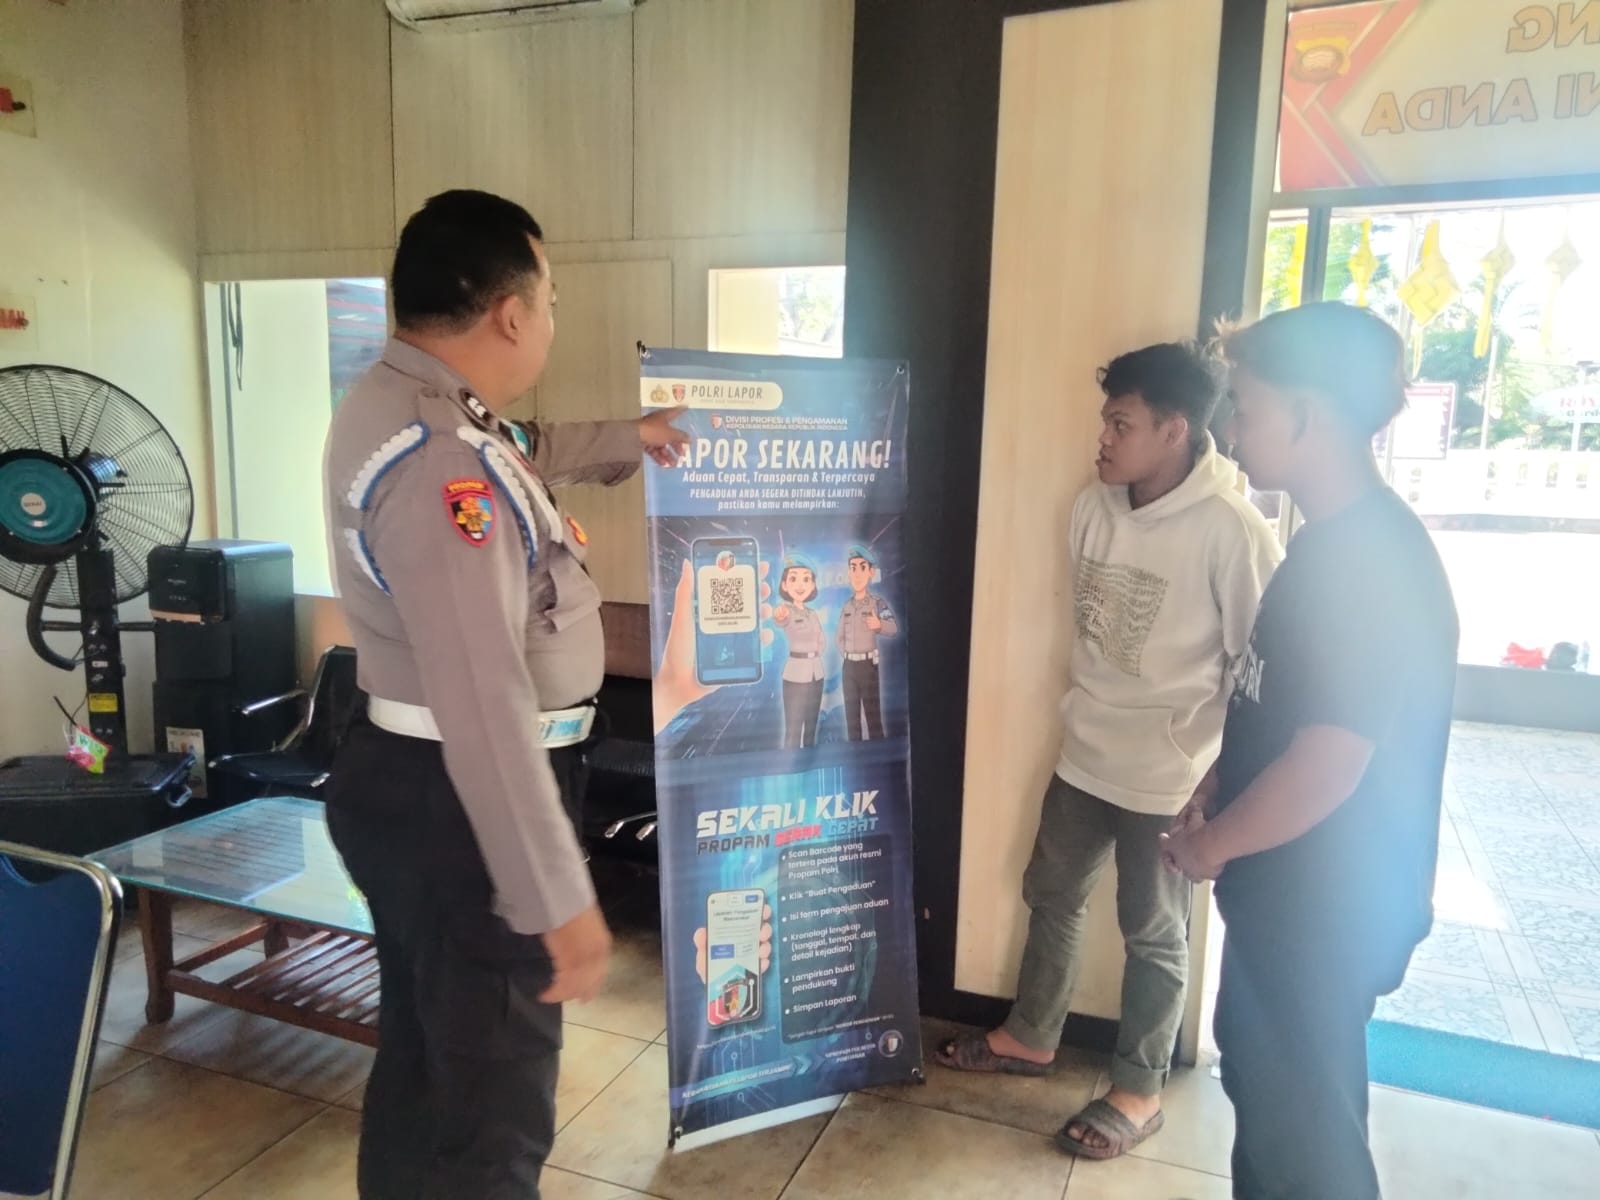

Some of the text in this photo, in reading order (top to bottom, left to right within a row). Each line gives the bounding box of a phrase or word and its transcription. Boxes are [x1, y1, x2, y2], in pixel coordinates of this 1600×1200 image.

[691, 385, 763, 400] POLRI LAPOR
[725, 415, 749, 425] DIVISI
[750, 415, 784, 425] PROFESI
[664, 438, 892, 469] APOR SEKARANG!
[682, 471, 876, 486] Aduan Cepat, Transparan & Terpercaya
[690, 488, 737, 499] PENGADUAN
[739, 488, 760, 499] ANDA
[761, 488, 789, 499] SEGERA
[791, 488, 826, 498] DITINDAK
[718, 500, 755, 512] pastikan
[757, 500, 780, 509] kamu
[696, 789, 880, 838] SEKALI KLIK
[697, 833, 771, 854] PROPAM
[788, 842, 863, 859] Scan Barcode yang
[817, 855, 838, 867] pada
[839, 852, 859, 862] akun
[859, 848, 882, 859] resmi
[788, 869, 820, 880] Propam
[789, 892, 803, 900] Klik
[800, 909, 819, 919] form
[820, 903, 863, 918] pengajuan
[863, 898, 889, 909] aduan
[790, 923, 861, 940] Kronologi lengkap
[860, 930, 876, 939] dan
[791, 942, 853, 962] detail kejadian)
[792, 963, 855, 982] Lampirkan bukti
[792, 978, 838, 995] pendukung
[793, 1000, 824, 1013] Simpan
